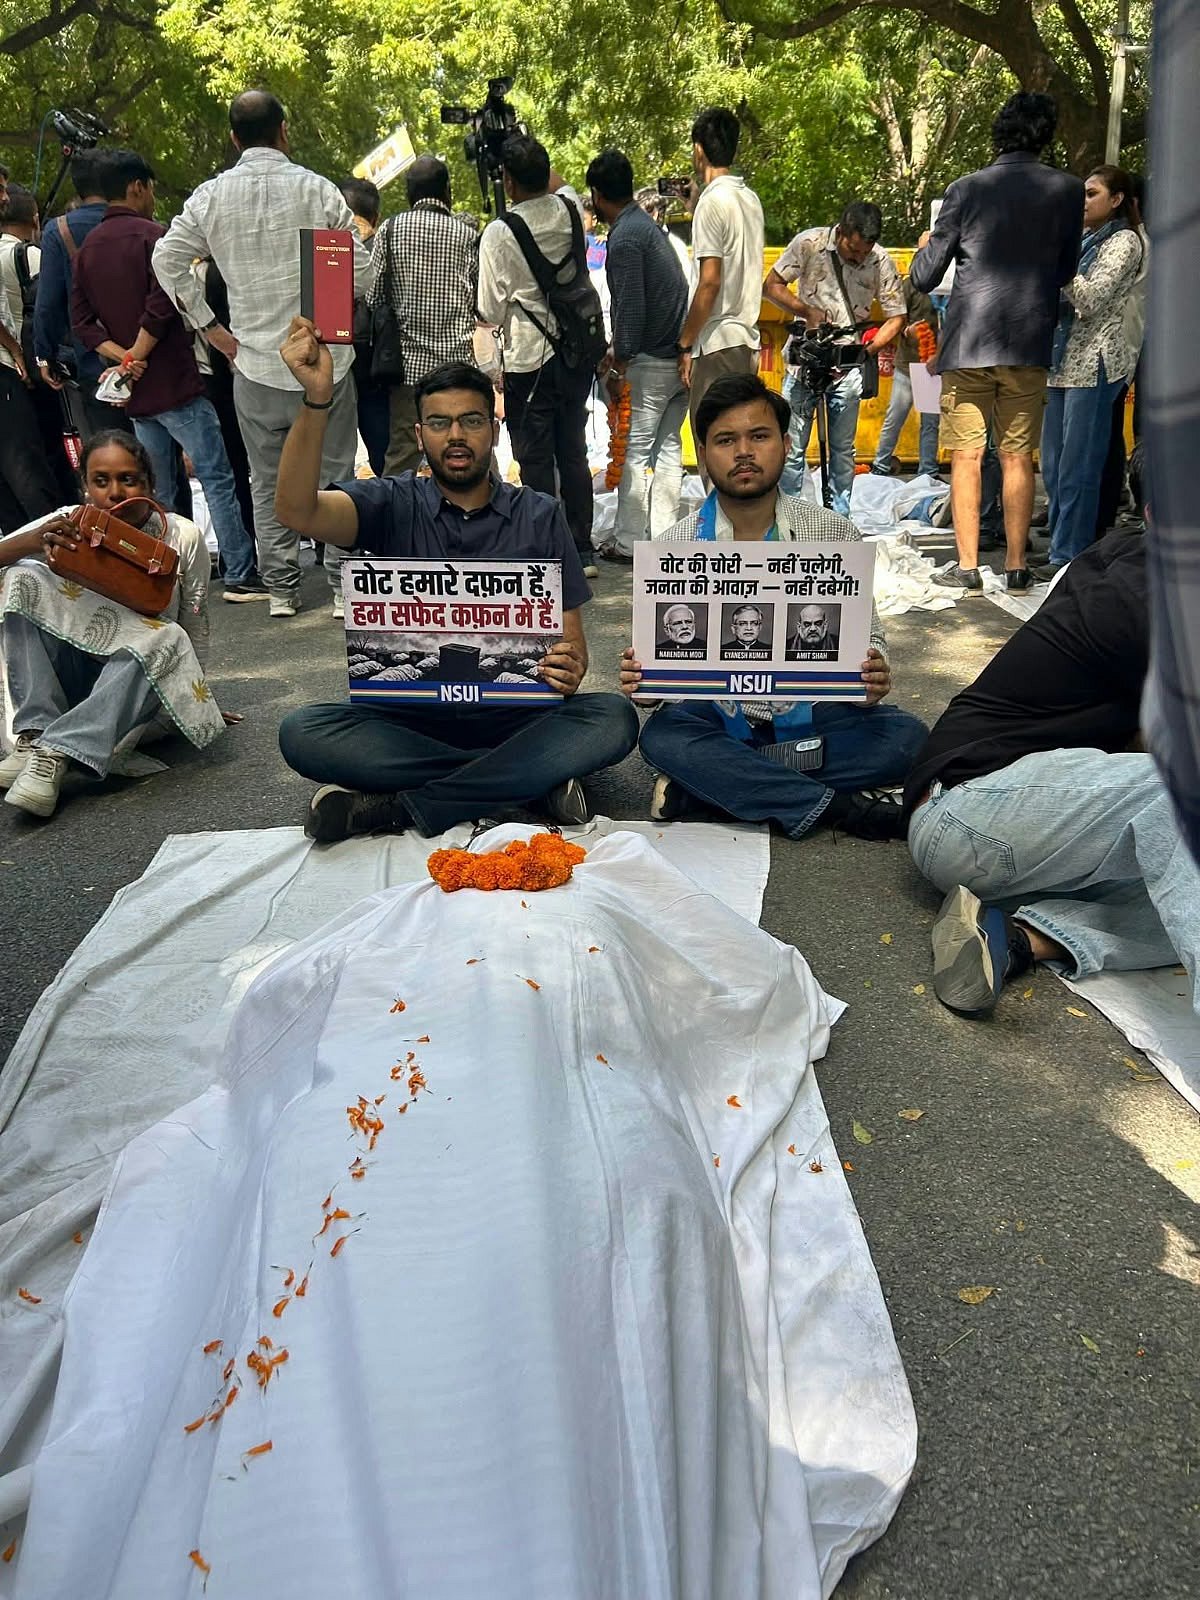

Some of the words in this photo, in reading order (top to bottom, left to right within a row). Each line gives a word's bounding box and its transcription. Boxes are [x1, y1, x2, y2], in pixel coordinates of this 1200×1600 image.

[659, 552, 685, 574] वोट
[688, 553, 708, 574] की
[710, 552, 742, 574] चोरी
[767, 553, 801, 574] नहीं
[800, 553, 846, 576] चलेगी,
[351, 563, 393, 595] वोट
[398, 564, 459, 596] हमारे
[463, 571, 524, 598] दफ़न
[527, 564, 551, 599] हैं,
[644, 579, 686, 596] जनता
[689, 574, 709, 596] की
[712, 579, 759, 598] आवाज़
[784, 575, 817, 596] नहीं
[816, 575, 859, 597] दबेगी!
[351, 601, 386, 626] हम
[389, 596, 446, 627] सफेद
[450, 603, 511, 629] कफ़न
[514, 598, 536, 628] में
[537, 598, 559, 629] हैं.
[659, 650, 688, 658] NARENDRA
[724, 651, 748, 659] GYANESH
[749, 651, 768, 659] KUMAR
[796, 652, 811, 660] AMIT
[812, 652, 828, 660] SHAH
[440, 684, 480, 702] NSUI
[729, 674, 773, 694] NSUI
